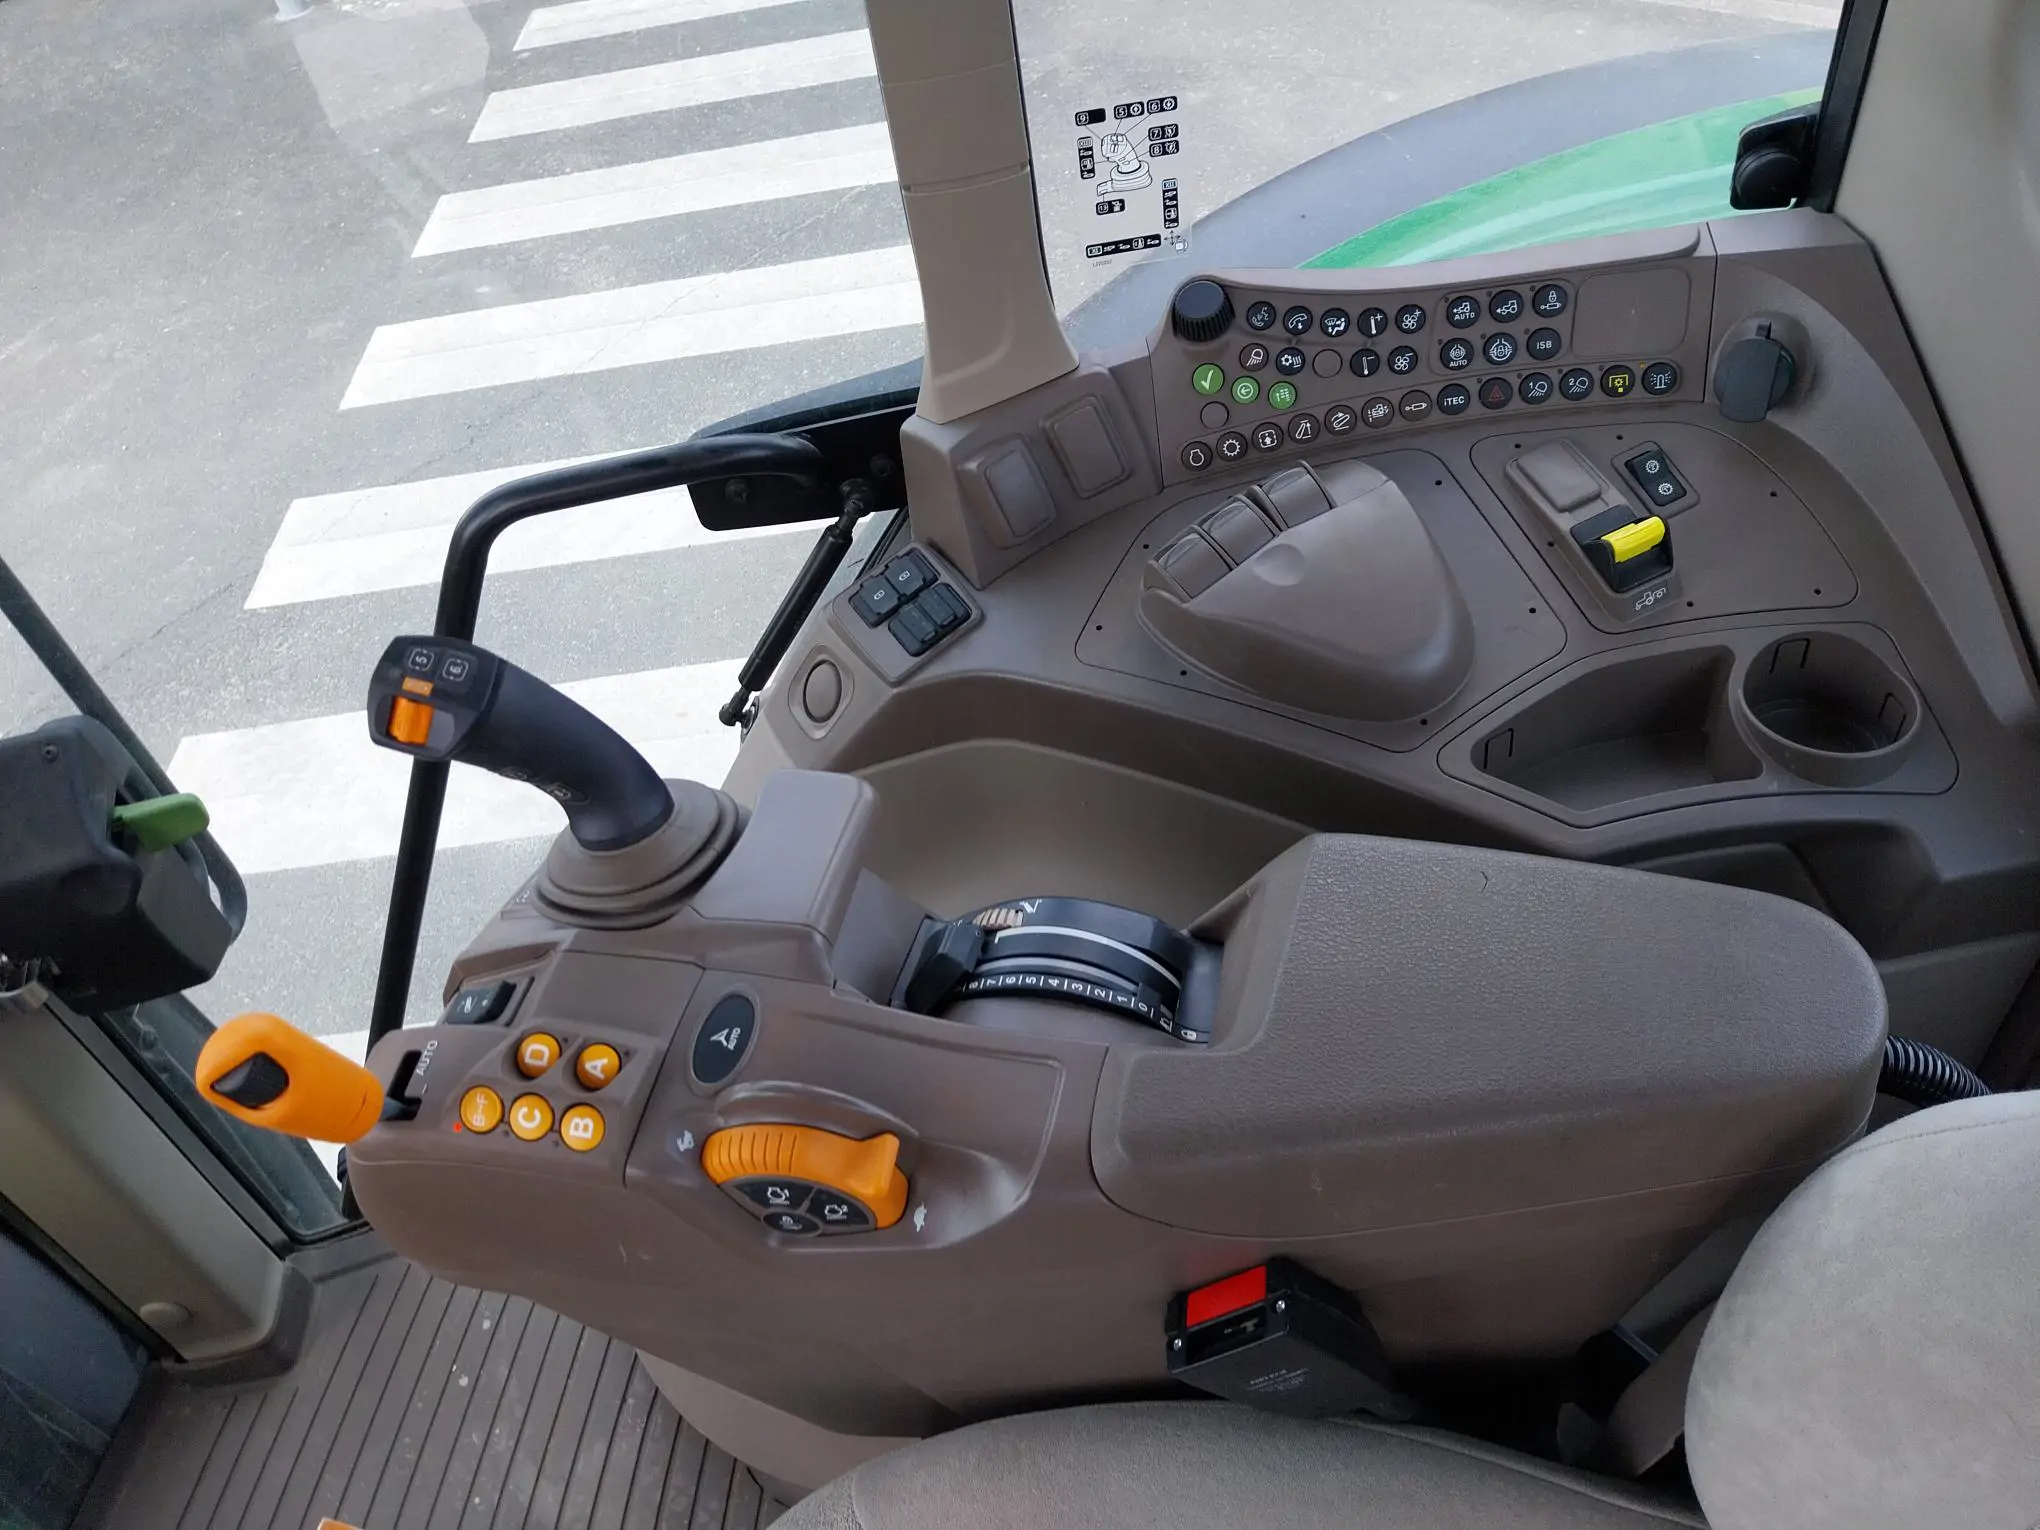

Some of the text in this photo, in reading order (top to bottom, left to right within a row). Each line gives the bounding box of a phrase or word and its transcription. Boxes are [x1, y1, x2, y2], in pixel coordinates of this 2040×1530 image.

[1454, 312, 1475, 321] AUTO
[1536, 340, 1552, 350] iSB
[1449, 359, 1468, 367] AUTO
[1529, 381, 1534, 389] 1
[1569, 378, 1575, 386] 2
[415, 655, 428, 664] 5
[986, 978, 996, 987] 7
[1005, 976, 1016, 984] 6
[1026, 976, 1037, 984] 5
[1048, 978, 1060, 987] 4
[1071, 983, 1083, 991] 3
[1094, 988, 1106, 998] 2
[1117, 995, 1128, 1003] 1
[1138, 1002, 1148, 1012] 0
[728, 1027, 741, 1050] AUTO
[416, 1040, 438, 1076] AUTO
[524, 1043, 550, 1067] D
[584, 1057, 609, 1080] A
[517, 1106, 542, 1129] C
[569, 1116, 594, 1139] B
